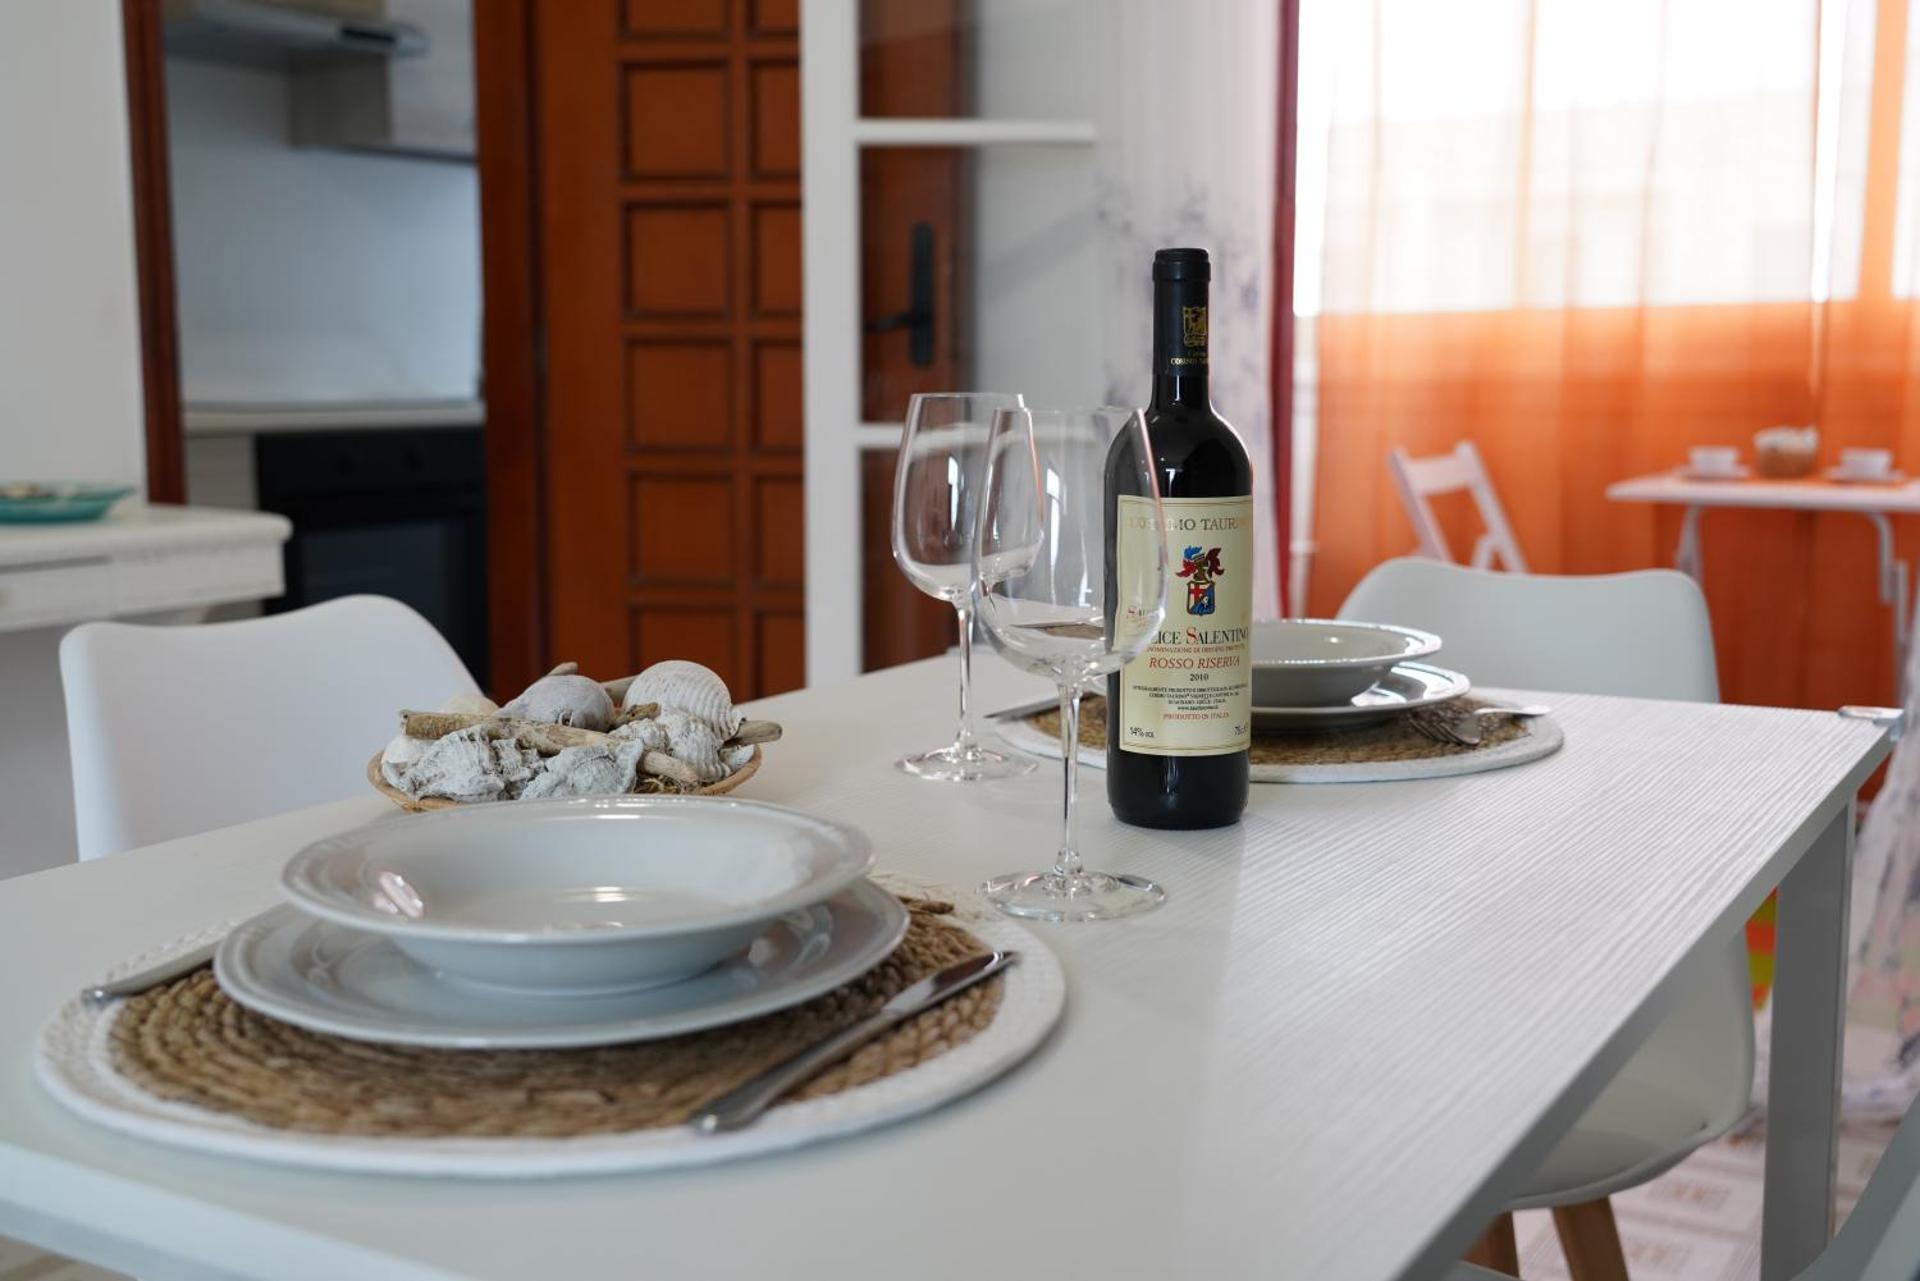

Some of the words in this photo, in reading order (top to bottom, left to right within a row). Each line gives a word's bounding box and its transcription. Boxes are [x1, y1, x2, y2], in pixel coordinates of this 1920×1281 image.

[1149, 657, 1194, 669] ROSSO
[1197, 655, 1240, 669] RISERVA
[1189, 673, 1209, 682] 2010
